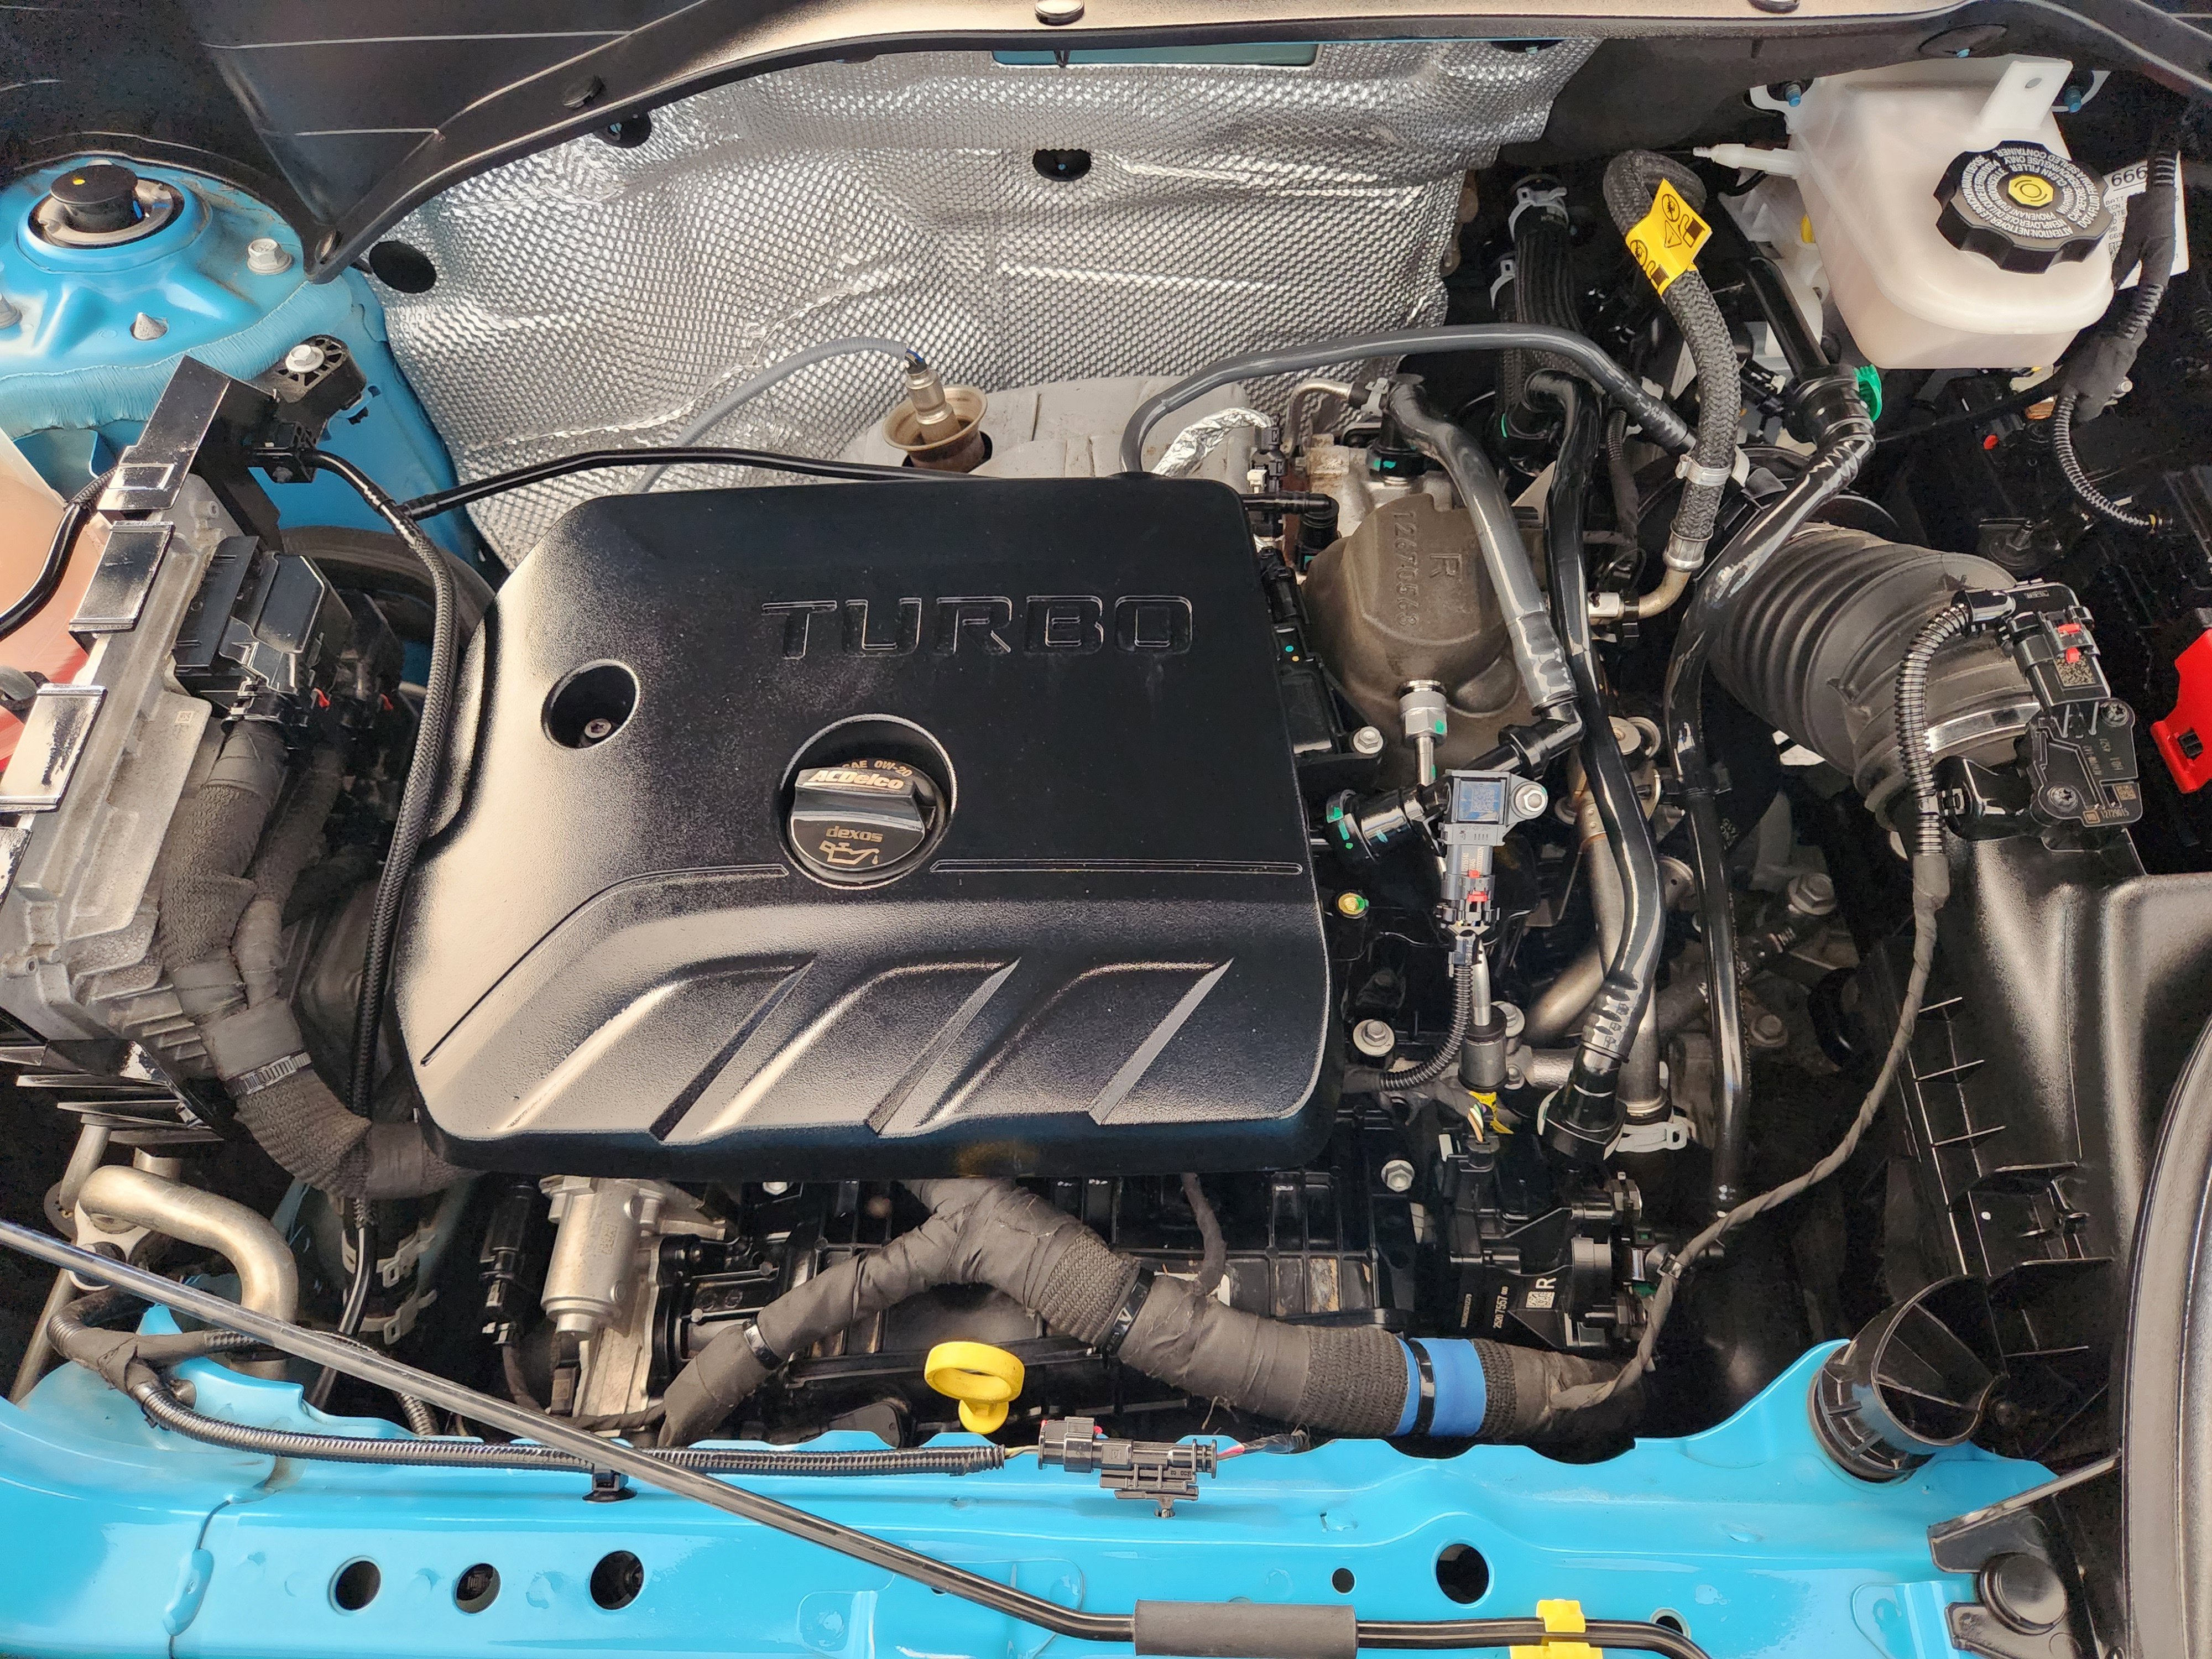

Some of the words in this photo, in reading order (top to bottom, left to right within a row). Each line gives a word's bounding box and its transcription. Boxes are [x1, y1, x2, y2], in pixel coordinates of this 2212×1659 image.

[1992, 148, 2047, 159] CONTAINER.
[2004, 155, 2025, 164] ONLY
[2027, 156, 2044, 166] USE
[2009, 164, 2041, 173] FILLER
[2047, 155, 2080, 174] SEALED
[2041, 168, 2067, 186] CLEAN
[2044, 160, 2083, 188] REMOVING
[2080, 176, 2099, 195] FROM
[1963, 189, 1986, 214] BOUCHON
[1976, 191, 1997, 212] LIQUIDE
[2056, 186, 2074, 215] WARNING:
[2074, 187, 2087, 211] BEFORE
[2088, 195, 2100, 211] FLUID
[1980, 211, 1993, 221] LE
[1992, 208, 2006, 218] DU
[2002, 213, 2019, 225] QUE
[2008, 208, 2056, 221] PROVENANT
[2067, 205, 2083, 221] CAP
[2077, 215, 2094, 228] DOT
[2087, 210, 2098, 218] 4
[1990, 216, 2031, 237] NETTOYER
[1430, 552, 1463, 578] R
[761, 595, 1193, 661] TURBO
[874, 760, 913, 778] 0W-20
[808, 769, 904, 790] ACDelco
[826, 825, 884, 842] dexos
[1535, 1277, 1557, 1290] R
